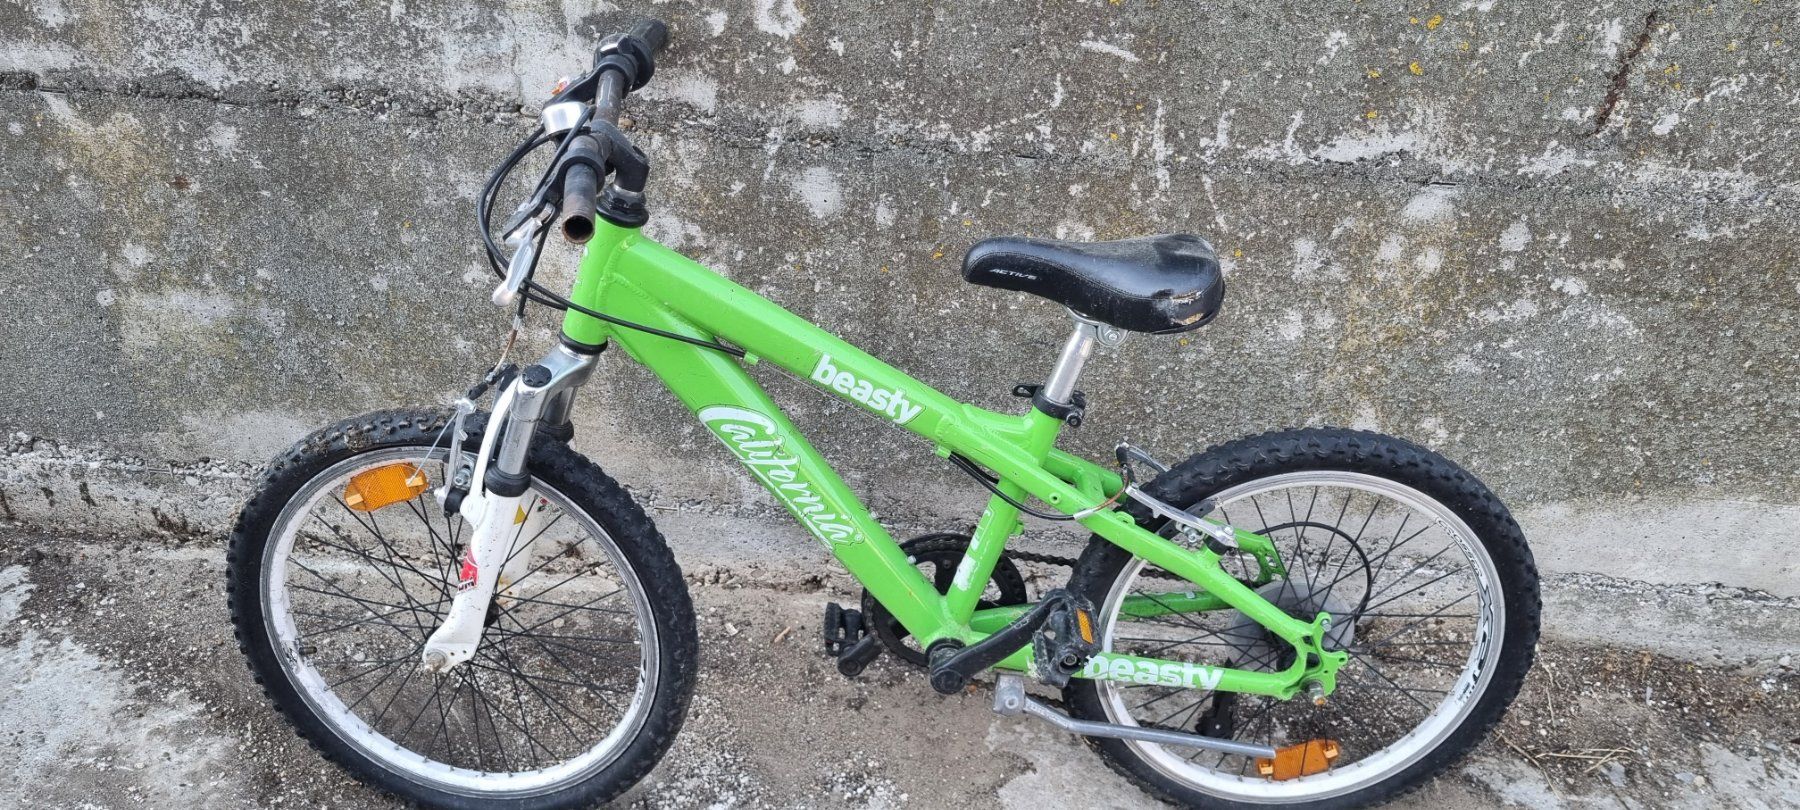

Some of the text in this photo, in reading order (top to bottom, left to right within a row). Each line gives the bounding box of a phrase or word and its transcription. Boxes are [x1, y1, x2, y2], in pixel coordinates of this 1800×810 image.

[989, 268, 1038, 280] ACTIVE
[811, 353, 923, 424] beasty
[698, 406, 855, 549] California
